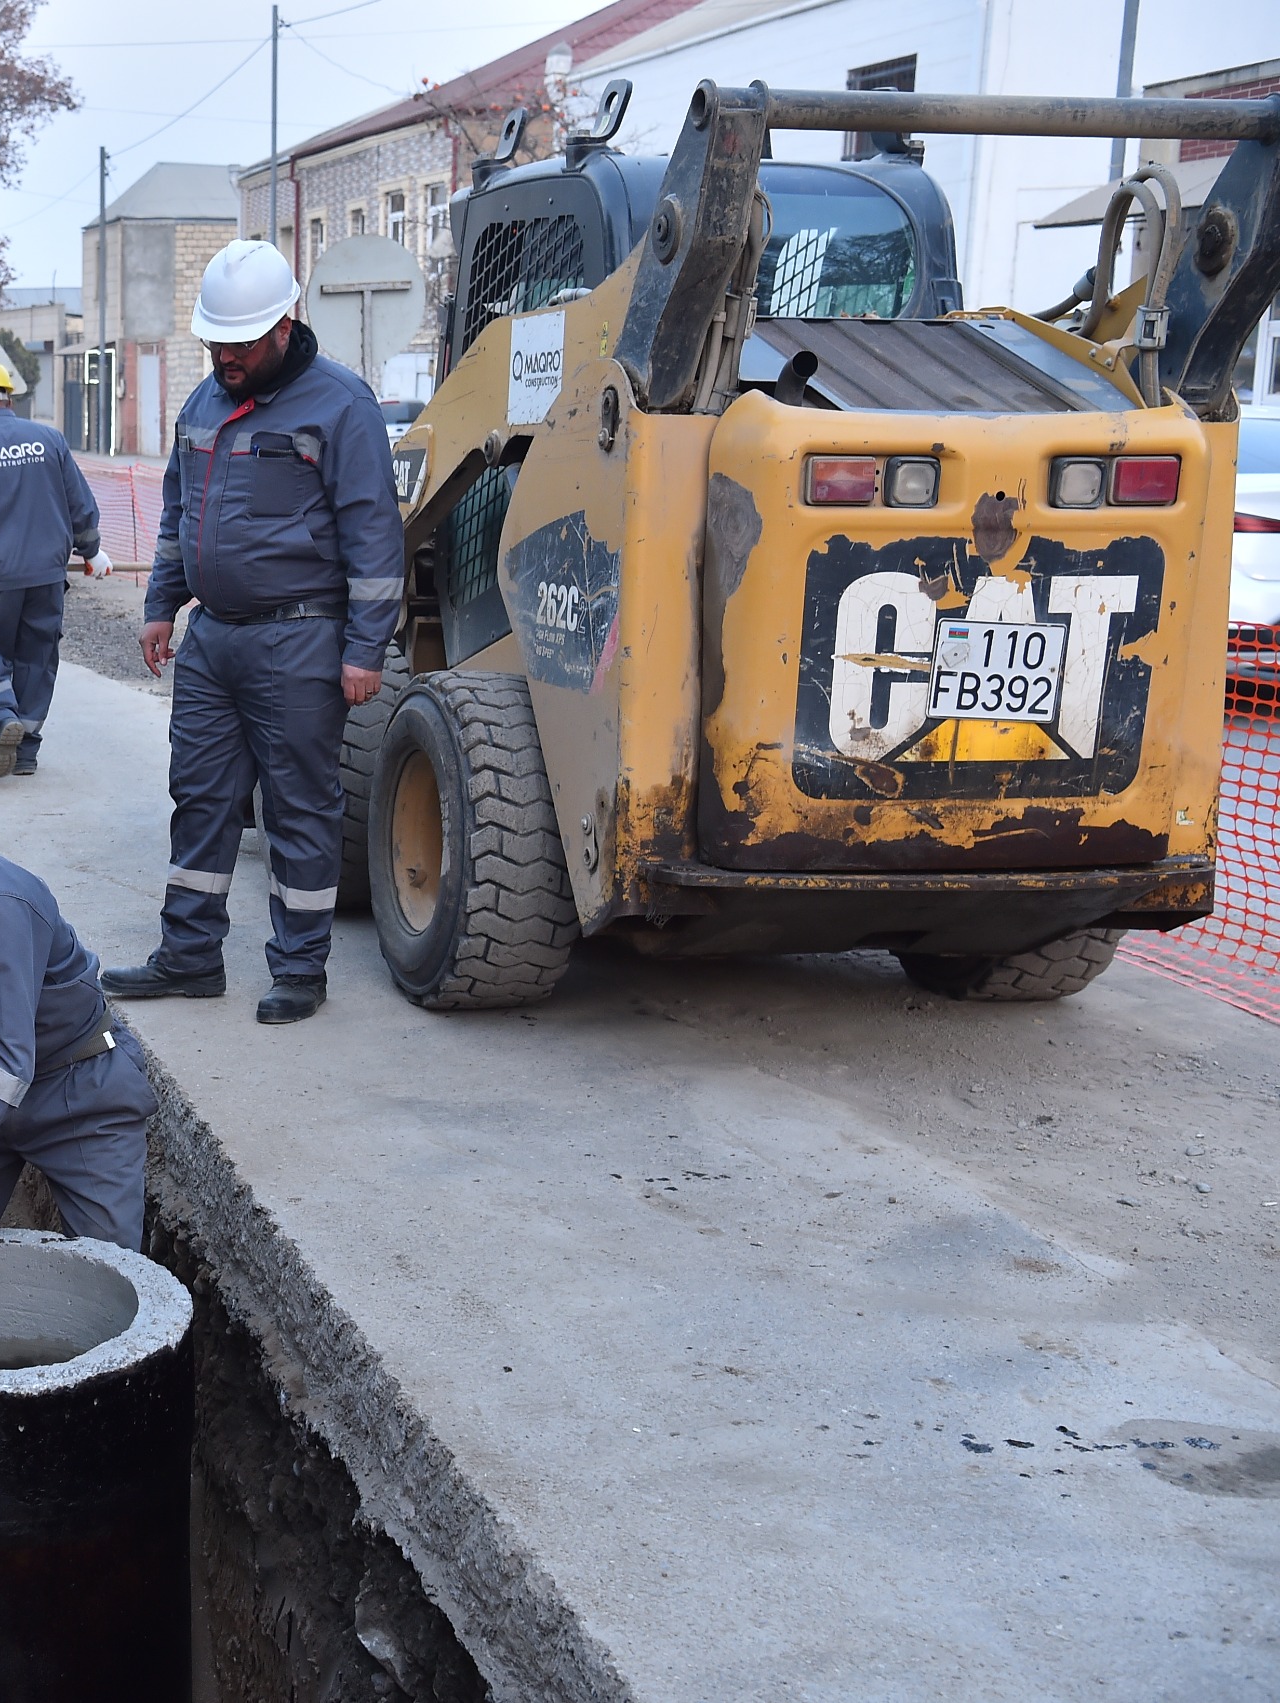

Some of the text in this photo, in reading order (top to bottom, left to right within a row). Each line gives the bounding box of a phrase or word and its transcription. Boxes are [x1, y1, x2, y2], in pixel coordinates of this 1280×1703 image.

[524, 350, 561, 374] MAQRO
[525, 376, 559, 389] CONSTRUCTION
[393, 460, 411, 496] CAT
[982, 628, 1047, 670] 110
[933, 670, 1053, 715] FB392
